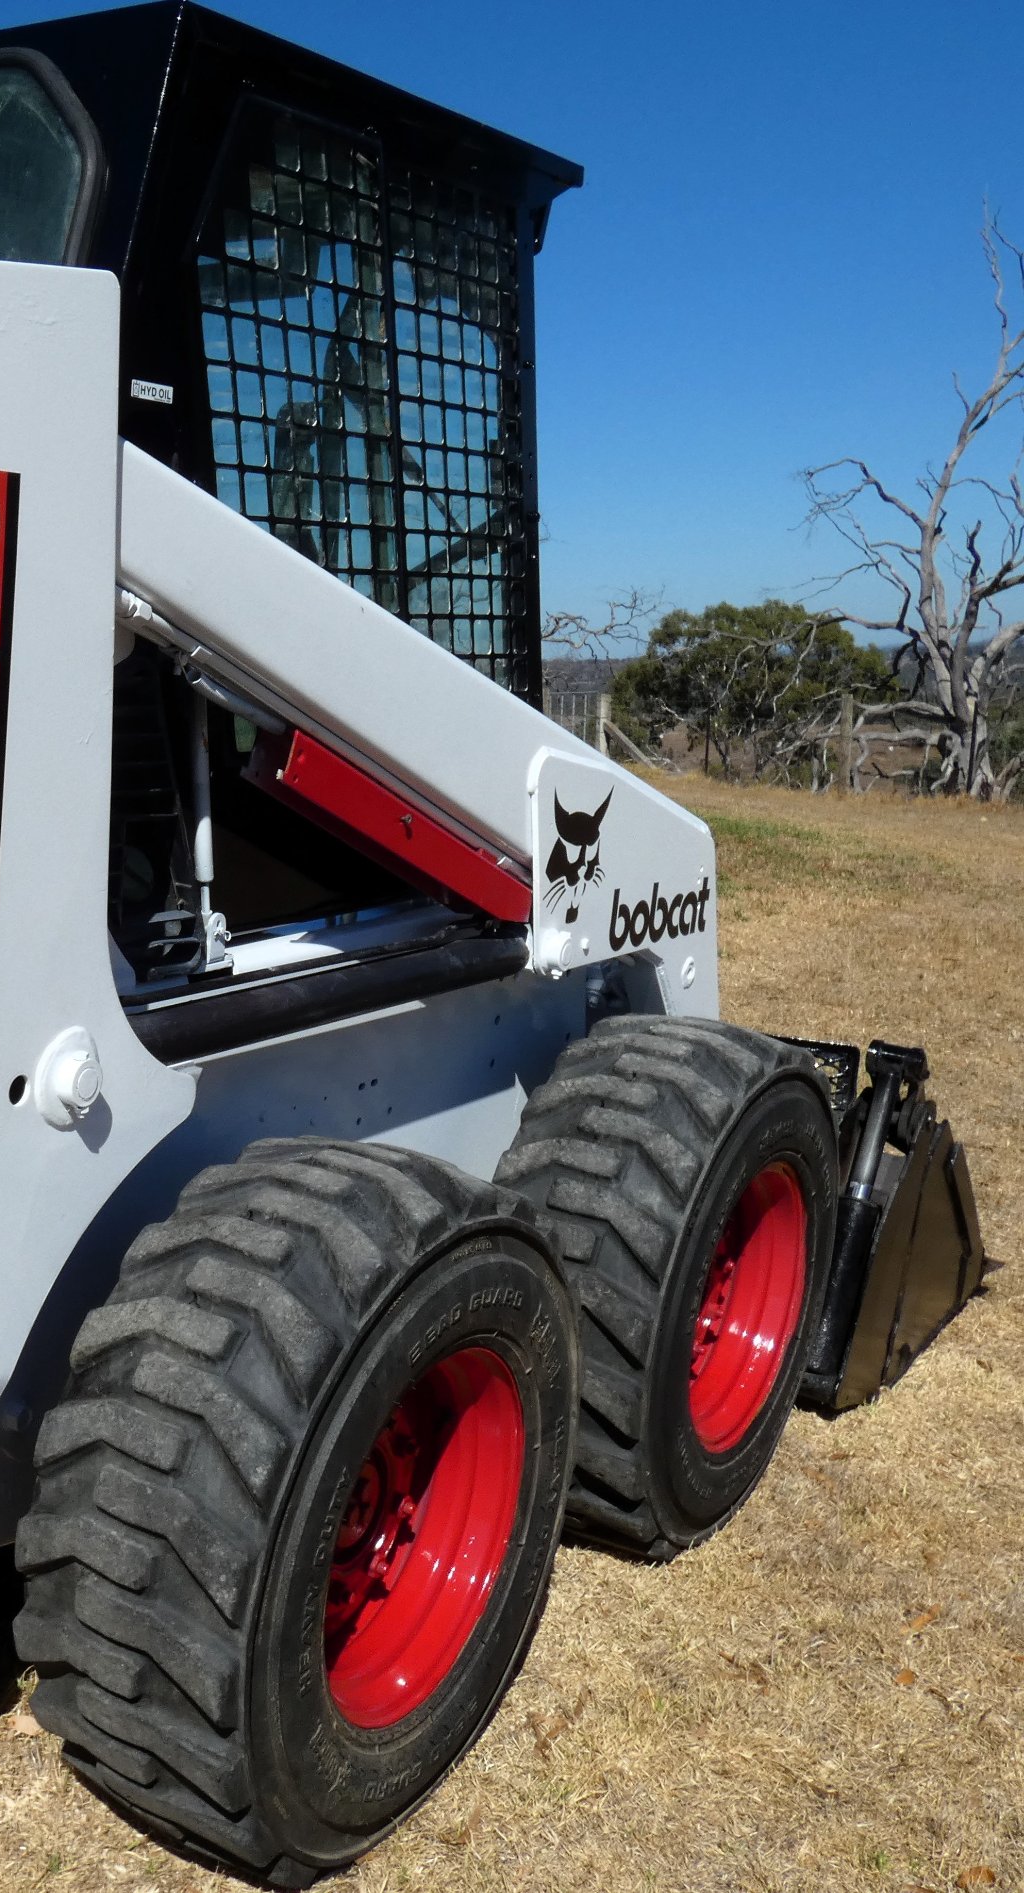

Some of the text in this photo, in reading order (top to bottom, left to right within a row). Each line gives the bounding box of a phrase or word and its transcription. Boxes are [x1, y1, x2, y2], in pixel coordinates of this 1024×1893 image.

[140, 384, 157, 397] HYD
[158, 388, 171, 400] OIL
[609, 877, 711, 952] bobcat
[408, 1302, 463, 1367] BEAD
[469, 1287, 524, 1312] GUARD
